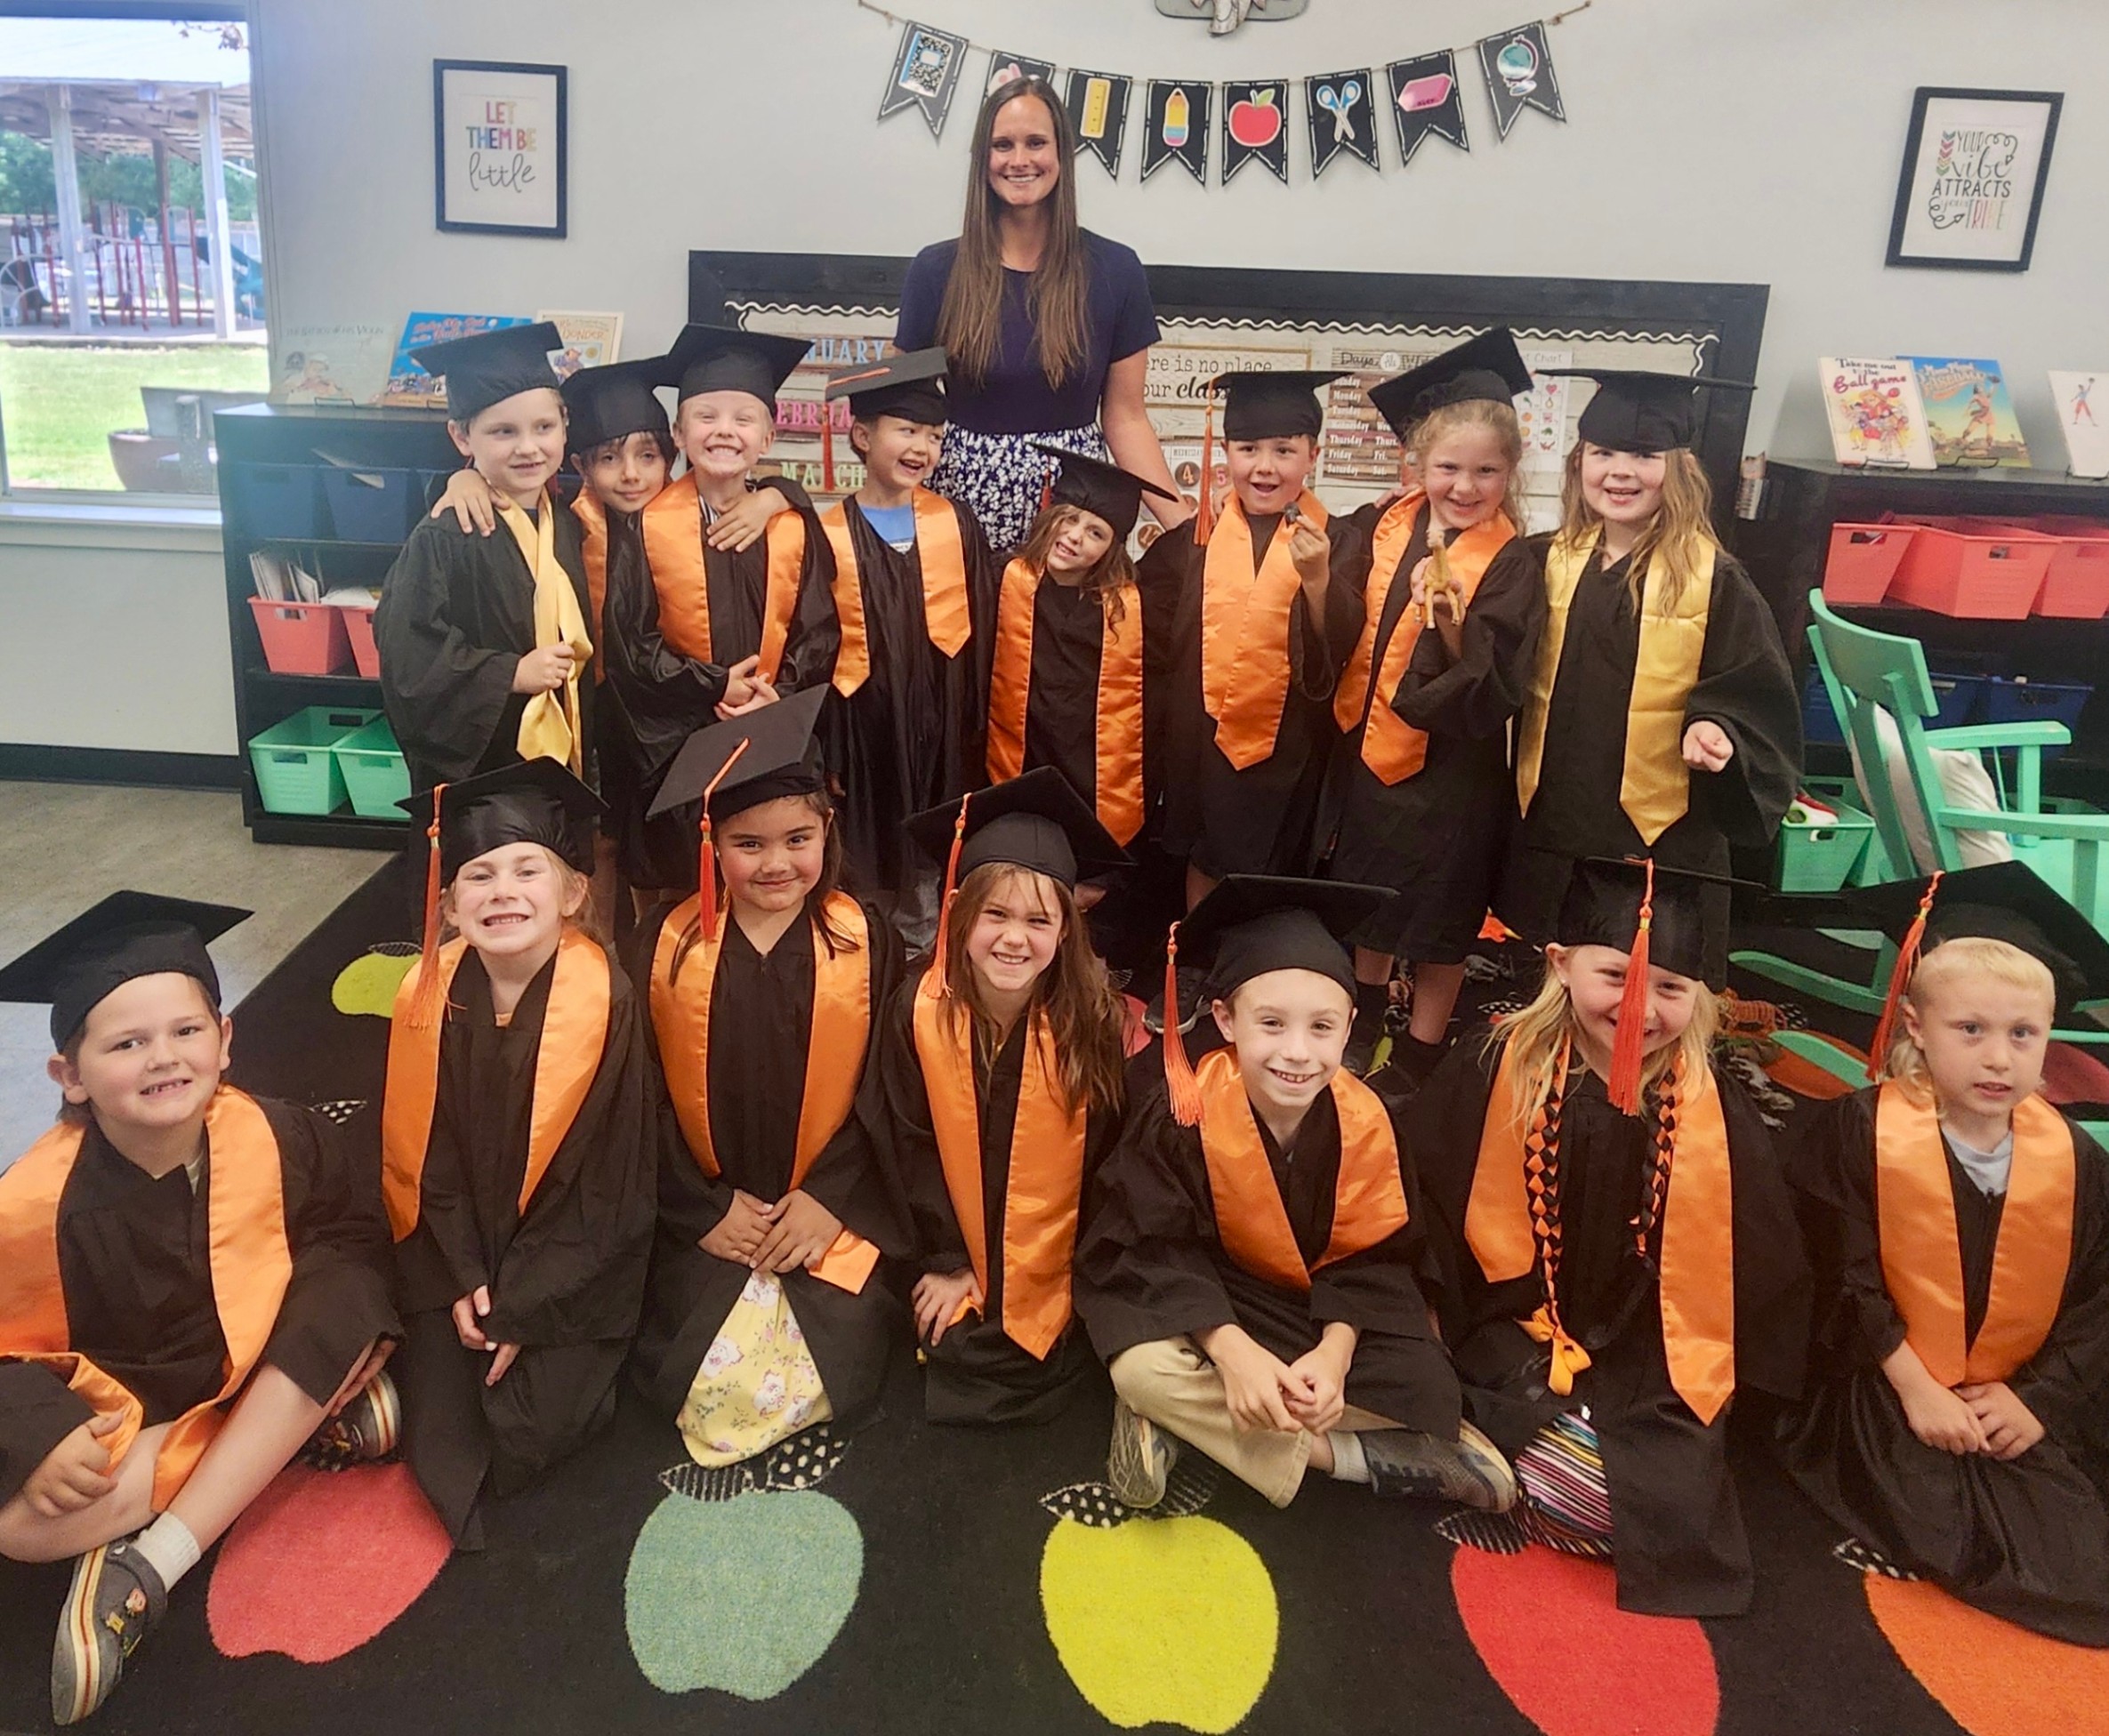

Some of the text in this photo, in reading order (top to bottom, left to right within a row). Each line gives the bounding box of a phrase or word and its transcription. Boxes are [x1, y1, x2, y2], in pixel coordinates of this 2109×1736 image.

[486, 100, 517, 125] LET
[465, 125, 537, 152] THEM BE
[1957, 131, 1984, 152] YOUR
[469, 151, 536, 193] little
[1952, 146, 2012, 179] vibe
[1932, 178, 2012, 198] ATTRACTS
[806, 339, 886, 366] UARY
[1340, 352, 1374, 368] Days
[1174, 355, 1193, 373] is
[1198, 358, 1219, 374] no
[1225, 356, 1272, 373] place
[1835, 358, 1862, 368] Take
[1833, 374, 1906, 394] Ball game
[1330, 434, 1364, 447] Thursday
[1329, 449, 1352, 461] Friday
[780, 461, 865, 488] MACH
[1182, 463, 1227, 486] 4 5
[1327, 463, 1358, 477] Saturday
